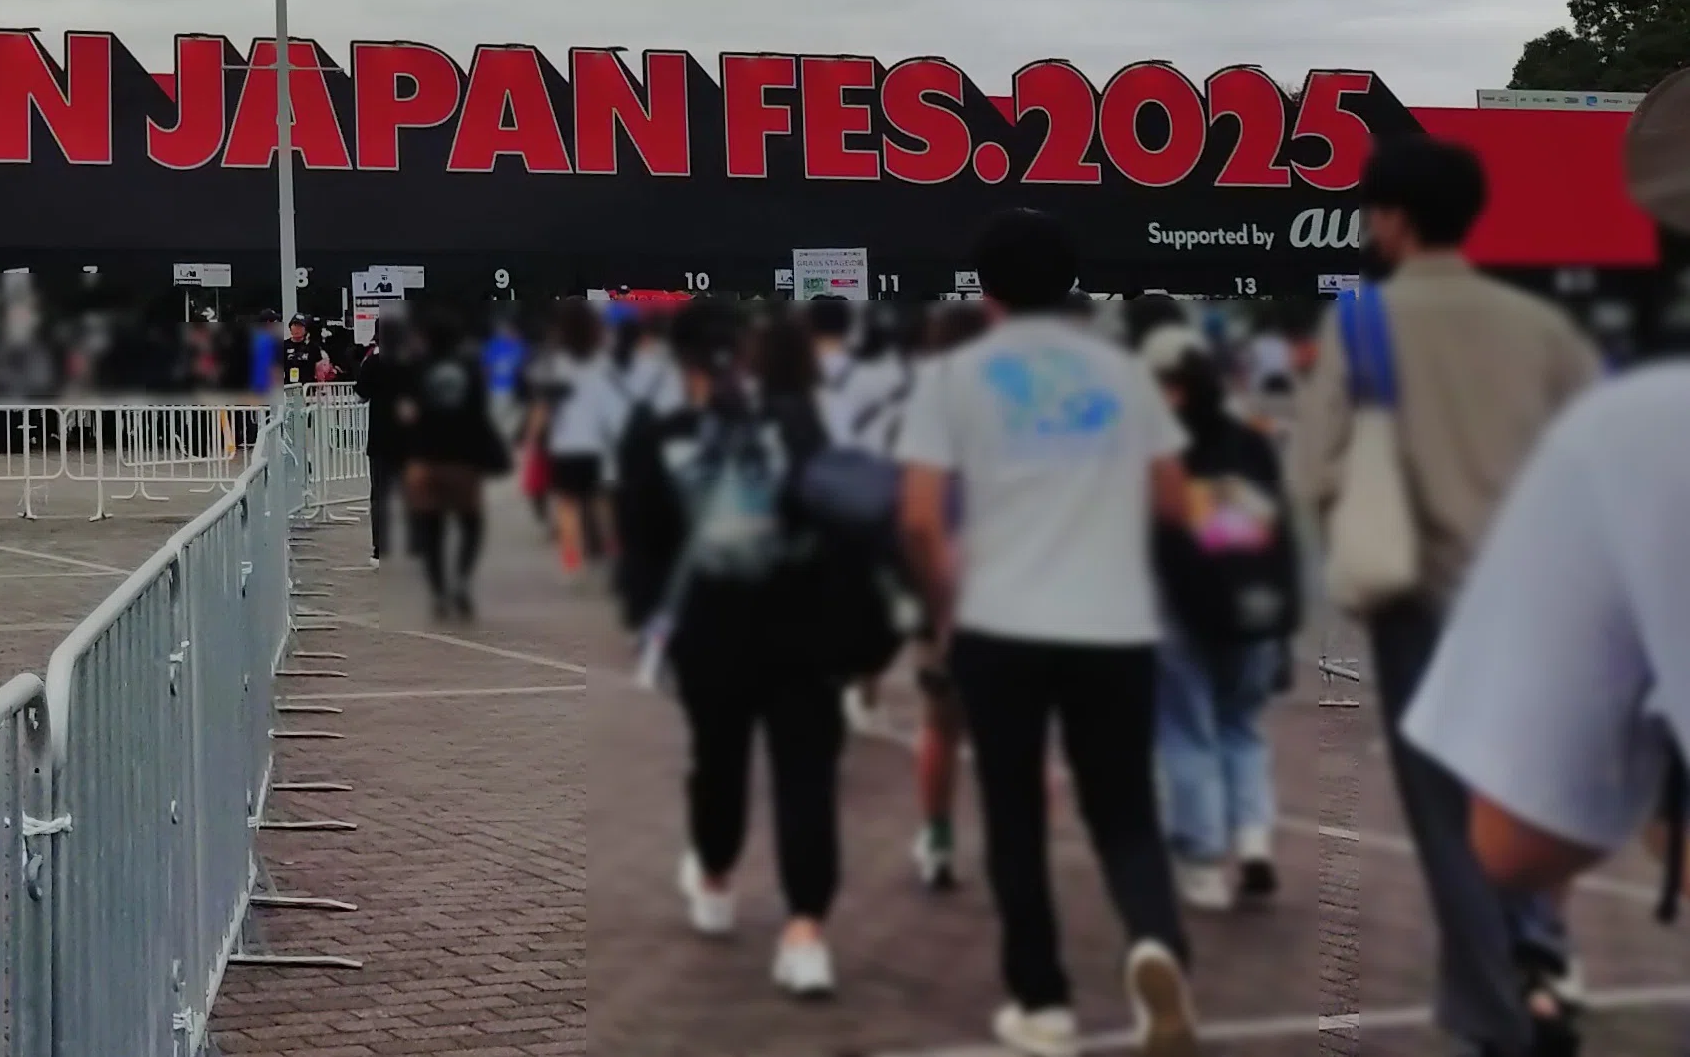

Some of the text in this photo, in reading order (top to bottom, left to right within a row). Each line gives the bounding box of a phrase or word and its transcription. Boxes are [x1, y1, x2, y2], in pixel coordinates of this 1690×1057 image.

[146, 35, 690, 177] JAPAN
[1147, 221, 1249, 251] Supported
[1252, 223, 1275, 251] by
[295, 267, 309, 288] 8
[494, 268, 510, 289] 9
[684, 271, 710, 291] 10
[878, 274, 899, 293] 11
[1234, 277, 1258, 295] 13
